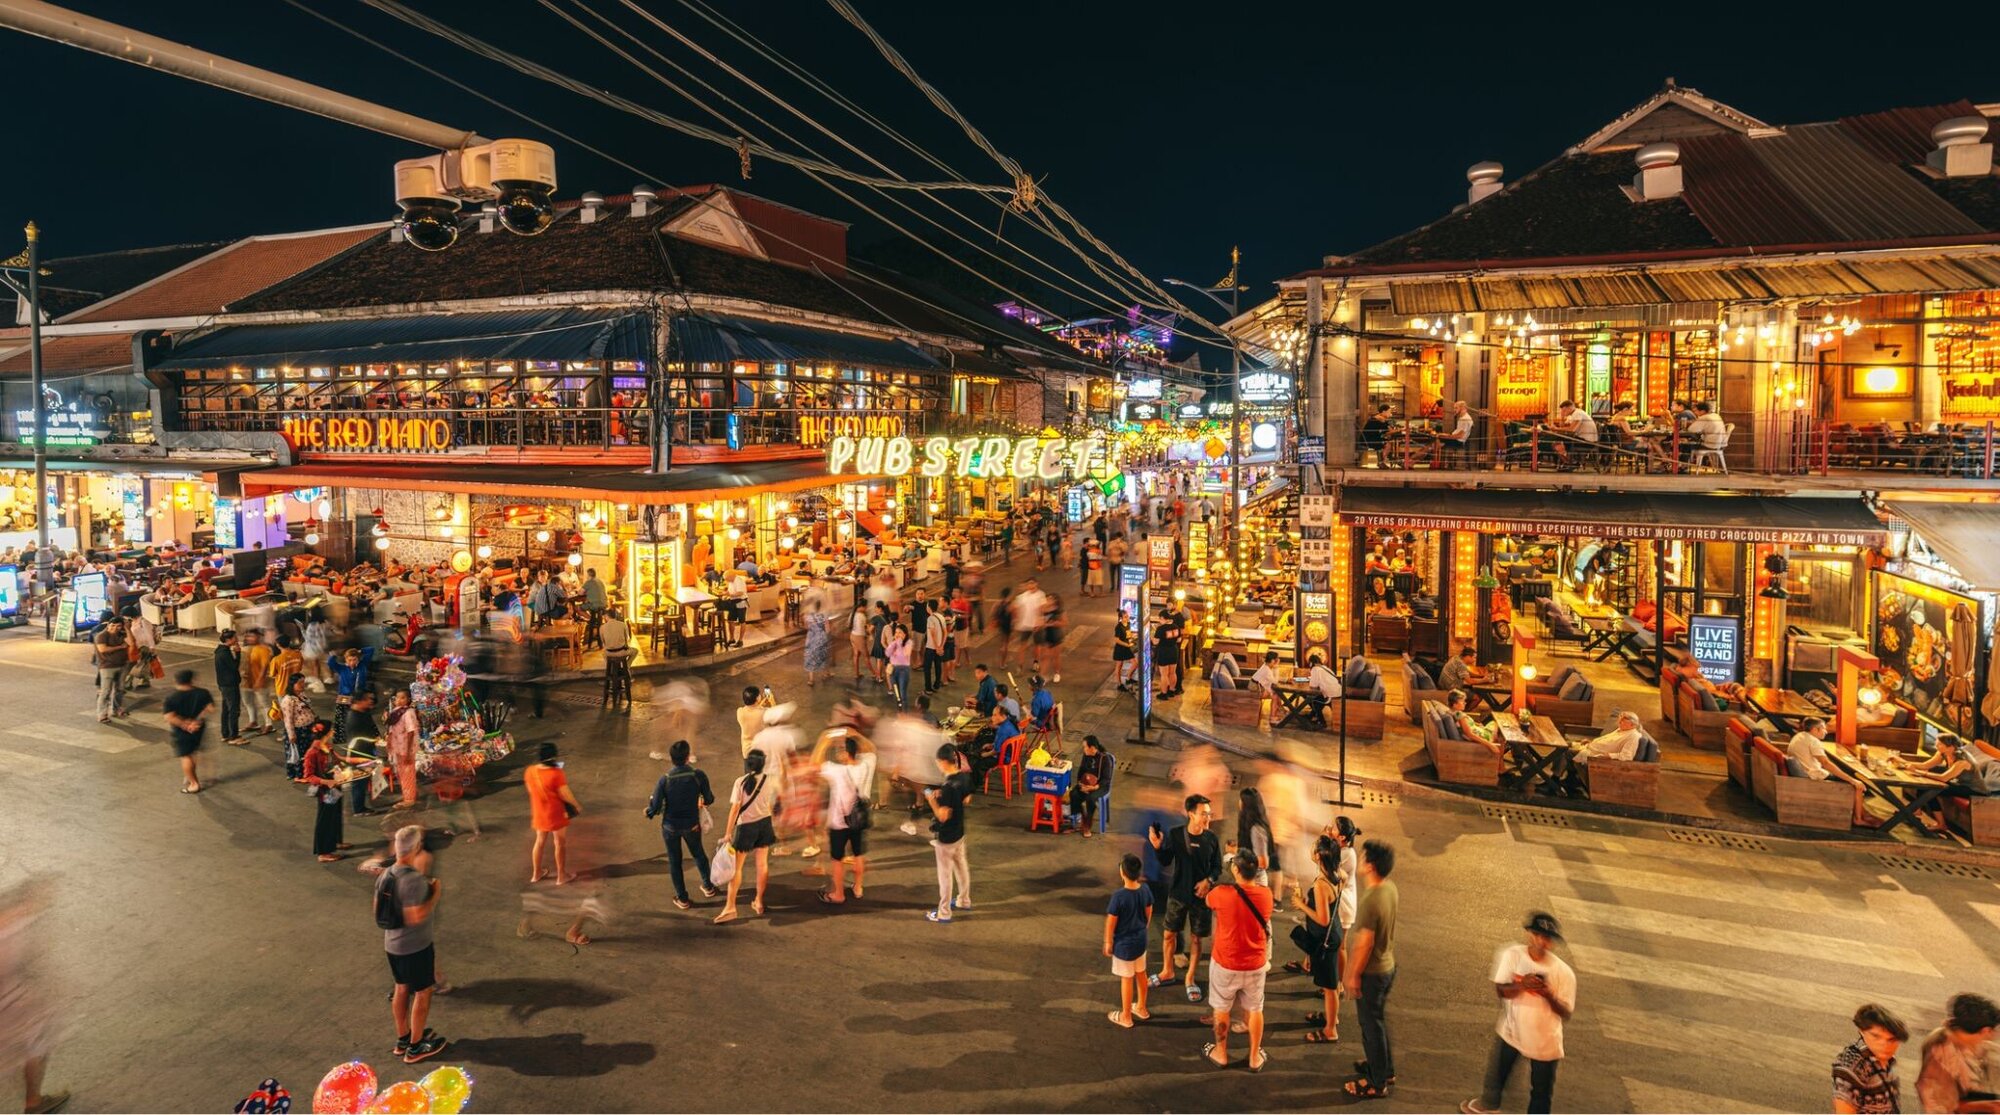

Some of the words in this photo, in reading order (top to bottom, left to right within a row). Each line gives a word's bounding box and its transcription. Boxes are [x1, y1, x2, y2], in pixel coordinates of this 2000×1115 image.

[283, 417, 324, 447] THE
[328, 417, 372, 447] RED
[379, 418, 450, 449] PIANO
[800, 416, 831, 445] THE
[834, 416, 863, 438] RED
[865, 416, 903, 438] PIANO
[830, 436, 913, 475] PUB
[921, 436, 1097, 479] STREET
[1355, 516, 1365, 524] 20
[1368, 516, 1394, 526] YEARS
[1398, 518, 1408, 527] OF
[1411, 518, 1462, 529] DELIVERING
[1465, 520, 1492, 530] GREAT
[1496, 522, 1533, 532] DINNING
[1536, 523, 1594, 535] EXPERIENCE
[1606, 526, 1624, 536] THE
[1627, 527, 1651, 537] BEST
[1655, 528, 1683, 538] WOOD
[1686, 528, 1716, 540] FIRED
[1720, 530, 1777, 542] CROCODILE
[1782, 532, 1813, 543] PIZZA
[1818, 533, 1828, 543] IN
[1833, 534, 1864, 545] TOWN
[1151, 540, 1169, 549] LIVE
[1306, 595, 1327, 604] Brick
[1306, 601, 1327, 609] Oven
[1695, 627, 1732, 642] LIVE
[1695, 641, 1732, 649] WESTERN
[1695, 649, 1732, 660] BAND
